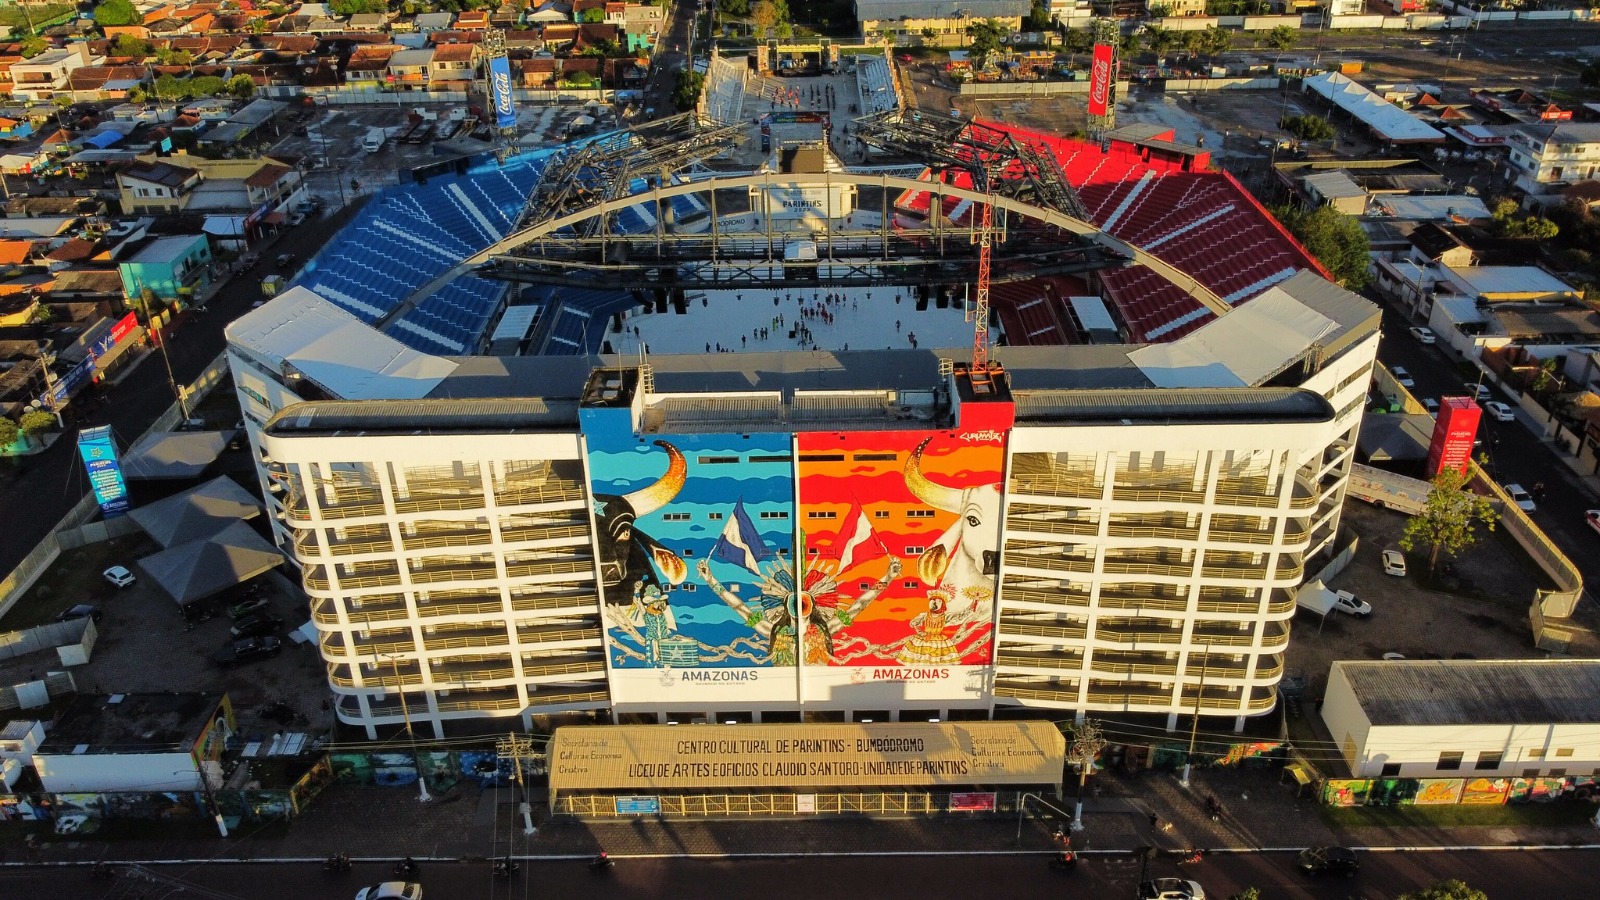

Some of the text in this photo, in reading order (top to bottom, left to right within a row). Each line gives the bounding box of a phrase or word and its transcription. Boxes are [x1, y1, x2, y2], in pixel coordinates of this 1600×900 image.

[682, 670, 758, 681] AMAZONAS
[873, 668, 949, 679] AMAZONAS
[677, 740, 716, 754] CENTRO
[719, 740, 772, 754] CULTURAL
[776, 740, 789, 754] DE
[793, 739, 845, 753] PARINTINS
[856, 735, 924, 752] BUMBÓDROMO
[1008, 747, 1045, 757] Economia
[973, 758, 1005, 768] Criativa
[629, 763, 656, 778] LICEU
[658, 763, 670, 778] DE
[672, 763, 710, 778] ARTES
[713, 763, 718, 777] E
[720, 762, 758, 777] OFICIOS
[763, 762, 807, 776] CLAUDIO
[917, 760, 968, 775] PARINTINS
